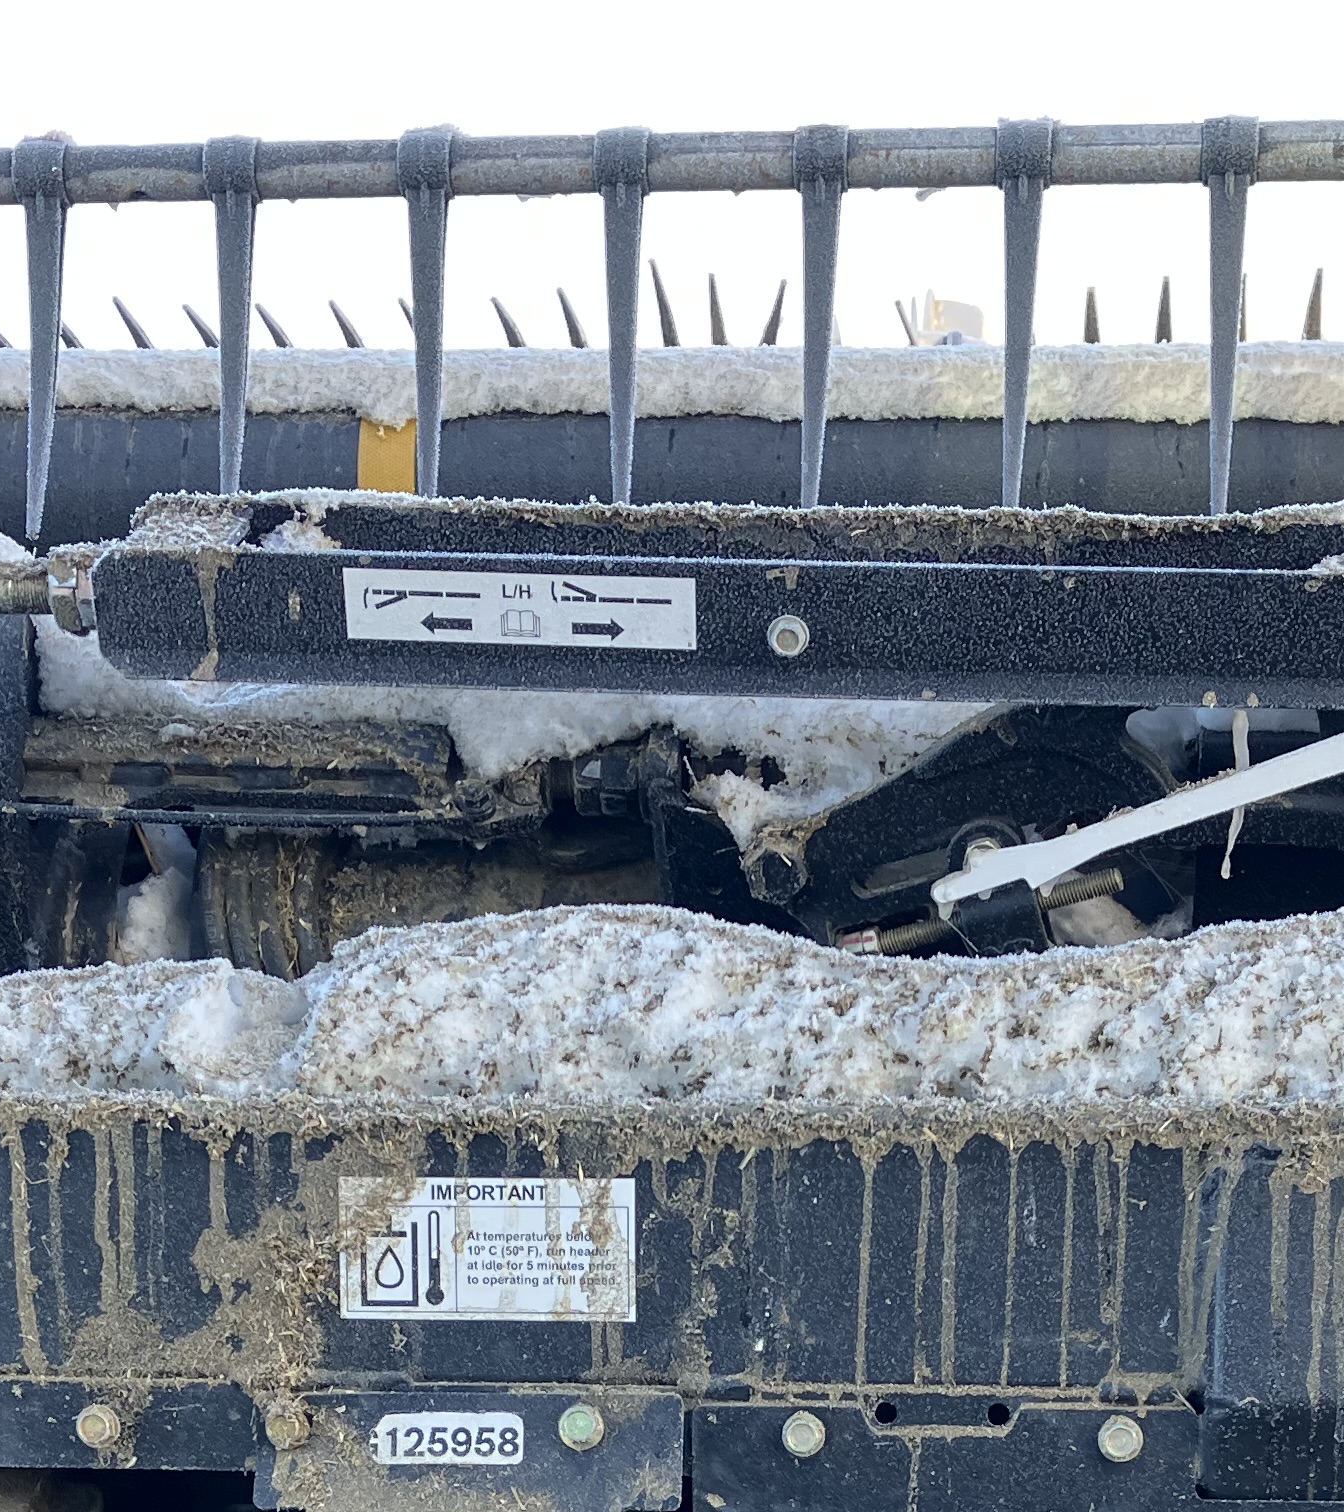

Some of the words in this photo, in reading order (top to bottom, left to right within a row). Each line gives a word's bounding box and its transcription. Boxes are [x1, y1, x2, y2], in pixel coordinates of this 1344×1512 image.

[502, 583, 532, 600] L/H
[430, 1185, 547, 1201] IMPORTANT
[467, 1232, 480, 1242] At
[483, 1232, 562, 1243] temperatures
[566, 1232, 593, 1242] belo
[488, 1246, 498, 1256] C
[527, 1246, 543, 1258] F),
[546, 1248, 566, 1256] run
[569, 1246, 611, 1257] header
[467, 1262, 478, 1271] at
[482, 1260, 502, 1271] idle
[506, 1260, 524, 1271] for
[526, 1261, 534, 1271] 5
[537, 1260, 585, 1271] minutes
[588, 1261, 618, 1274] prior
[467, 1276, 479, 1285] to
[482, 1276, 539, 1288] operating
[542, 1276, 554, 1285] at
[557, 1275, 576, 1285] full
